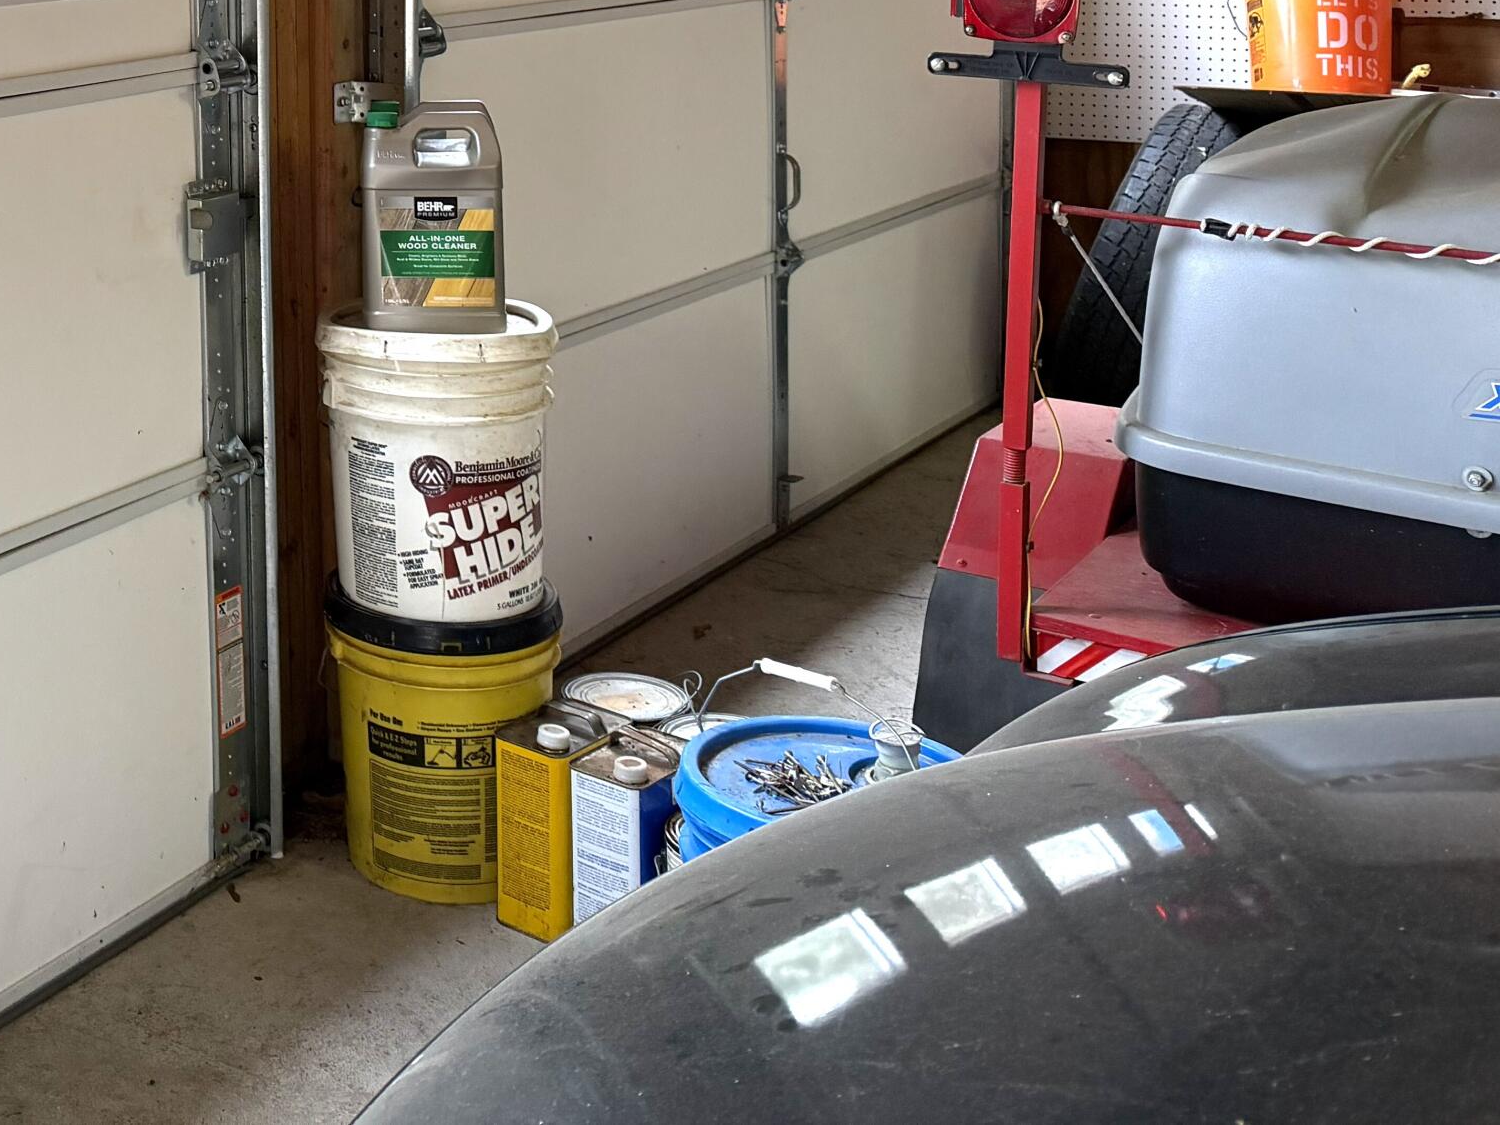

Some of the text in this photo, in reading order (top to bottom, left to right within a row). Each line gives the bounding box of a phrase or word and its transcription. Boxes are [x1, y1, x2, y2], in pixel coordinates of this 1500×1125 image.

[1317, 11, 1378, 51] DO
[1315, 53, 1382, 82] THIS.
[417, 201, 443, 211] BEHR
[455, 459, 505, 474] Benjamin
[505, 455, 530, 468] Moore
[455, 473, 515, 484] PROFESSIONAL
[426, 473, 541, 549] SUPER
[454, 514, 542, 584] HIDE
[447, 583, 476, 600] LATEX
[509, 584, 529, 598] WHITE
